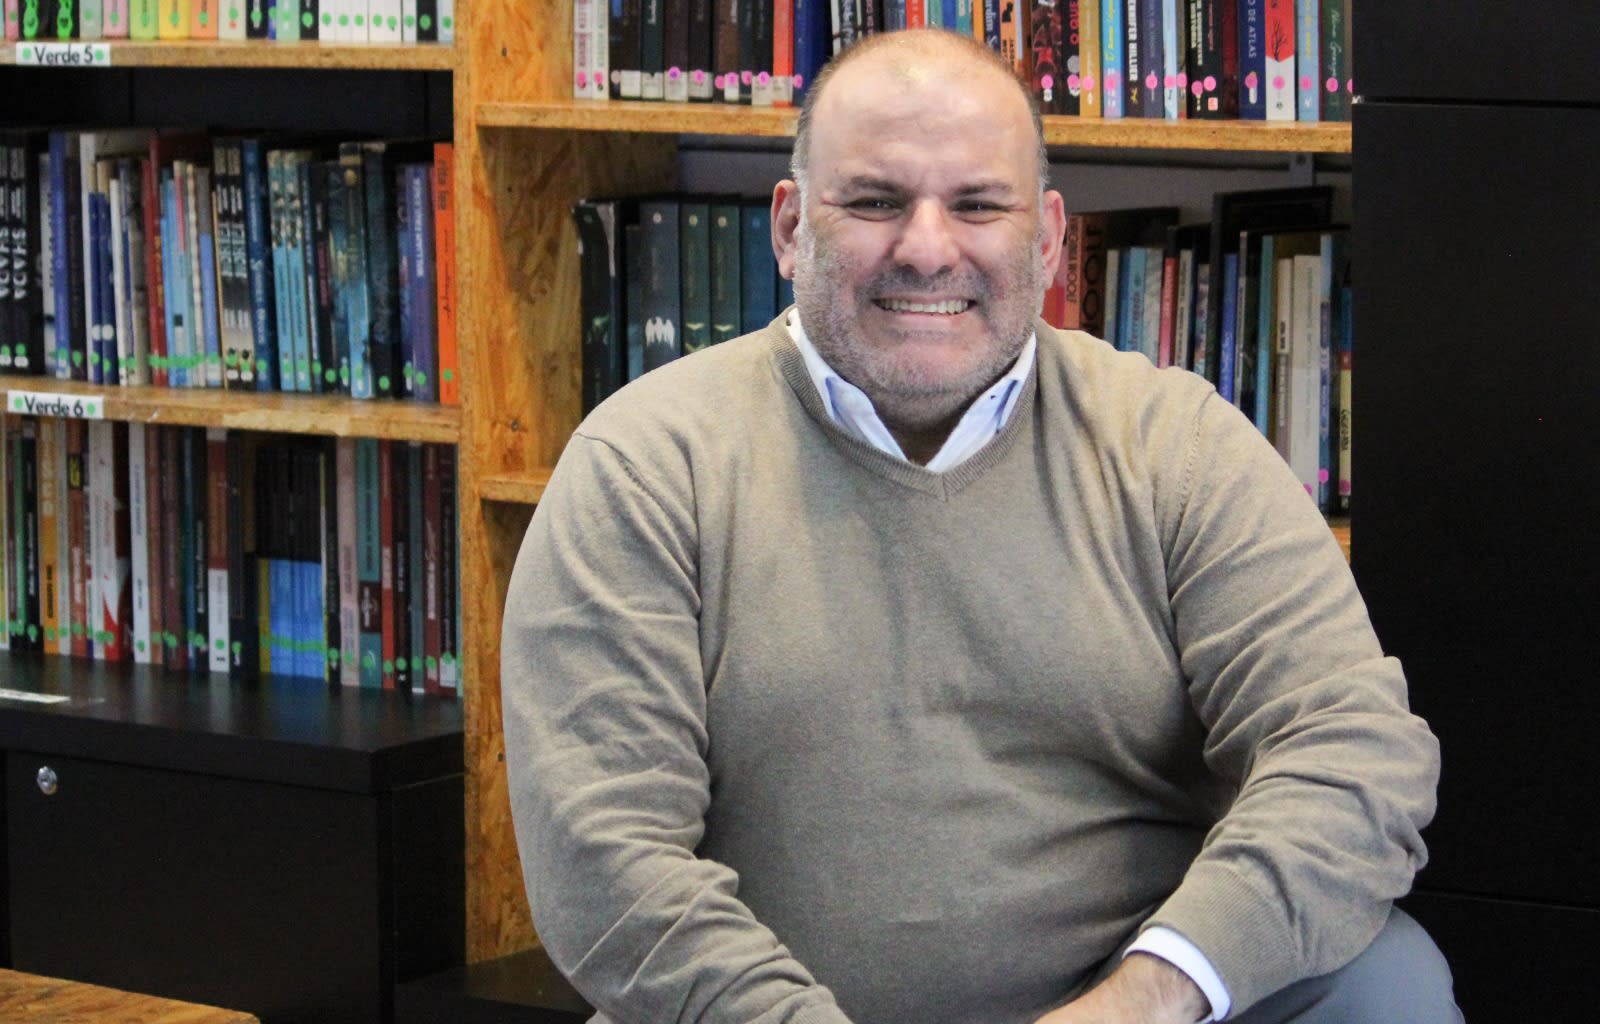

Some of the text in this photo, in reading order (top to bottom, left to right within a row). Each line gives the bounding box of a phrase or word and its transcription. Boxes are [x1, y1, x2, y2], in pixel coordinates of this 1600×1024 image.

[1128, 0, 1137, 41] ENNIFER
[1248, 9, 1256, 22] DE
[34, 44, 93, 65] Verde 5
[1248, 26, 1257, 59] ATLAS
[1067, 263, 1078, 304] WOOLF
[24, 395, 84, 417] Verde 6
